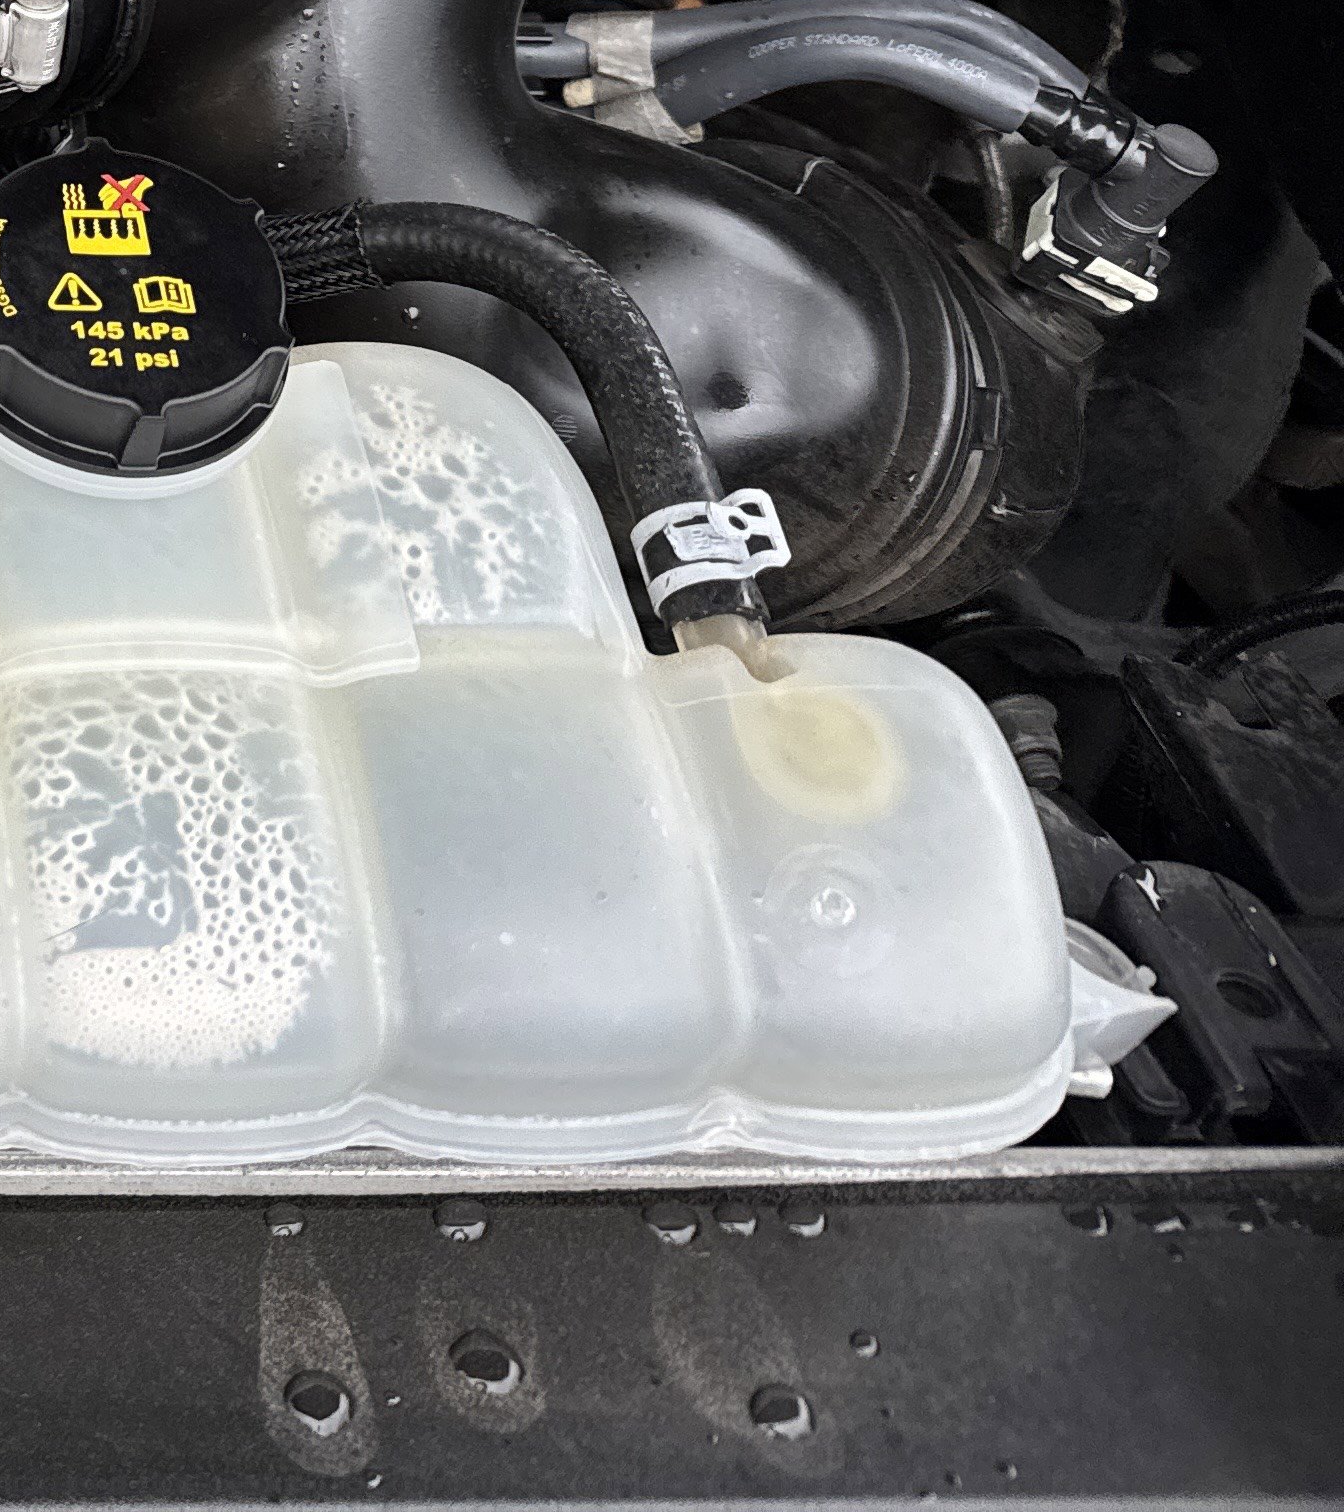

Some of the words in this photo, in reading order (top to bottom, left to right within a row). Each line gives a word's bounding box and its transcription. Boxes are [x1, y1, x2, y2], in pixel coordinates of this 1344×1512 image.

[70, 320, 125, 340] 145
[132, 322, 189, 341] kPa
[89, 347, 123, 368] 21
[135, 349, 179, 372] psi
